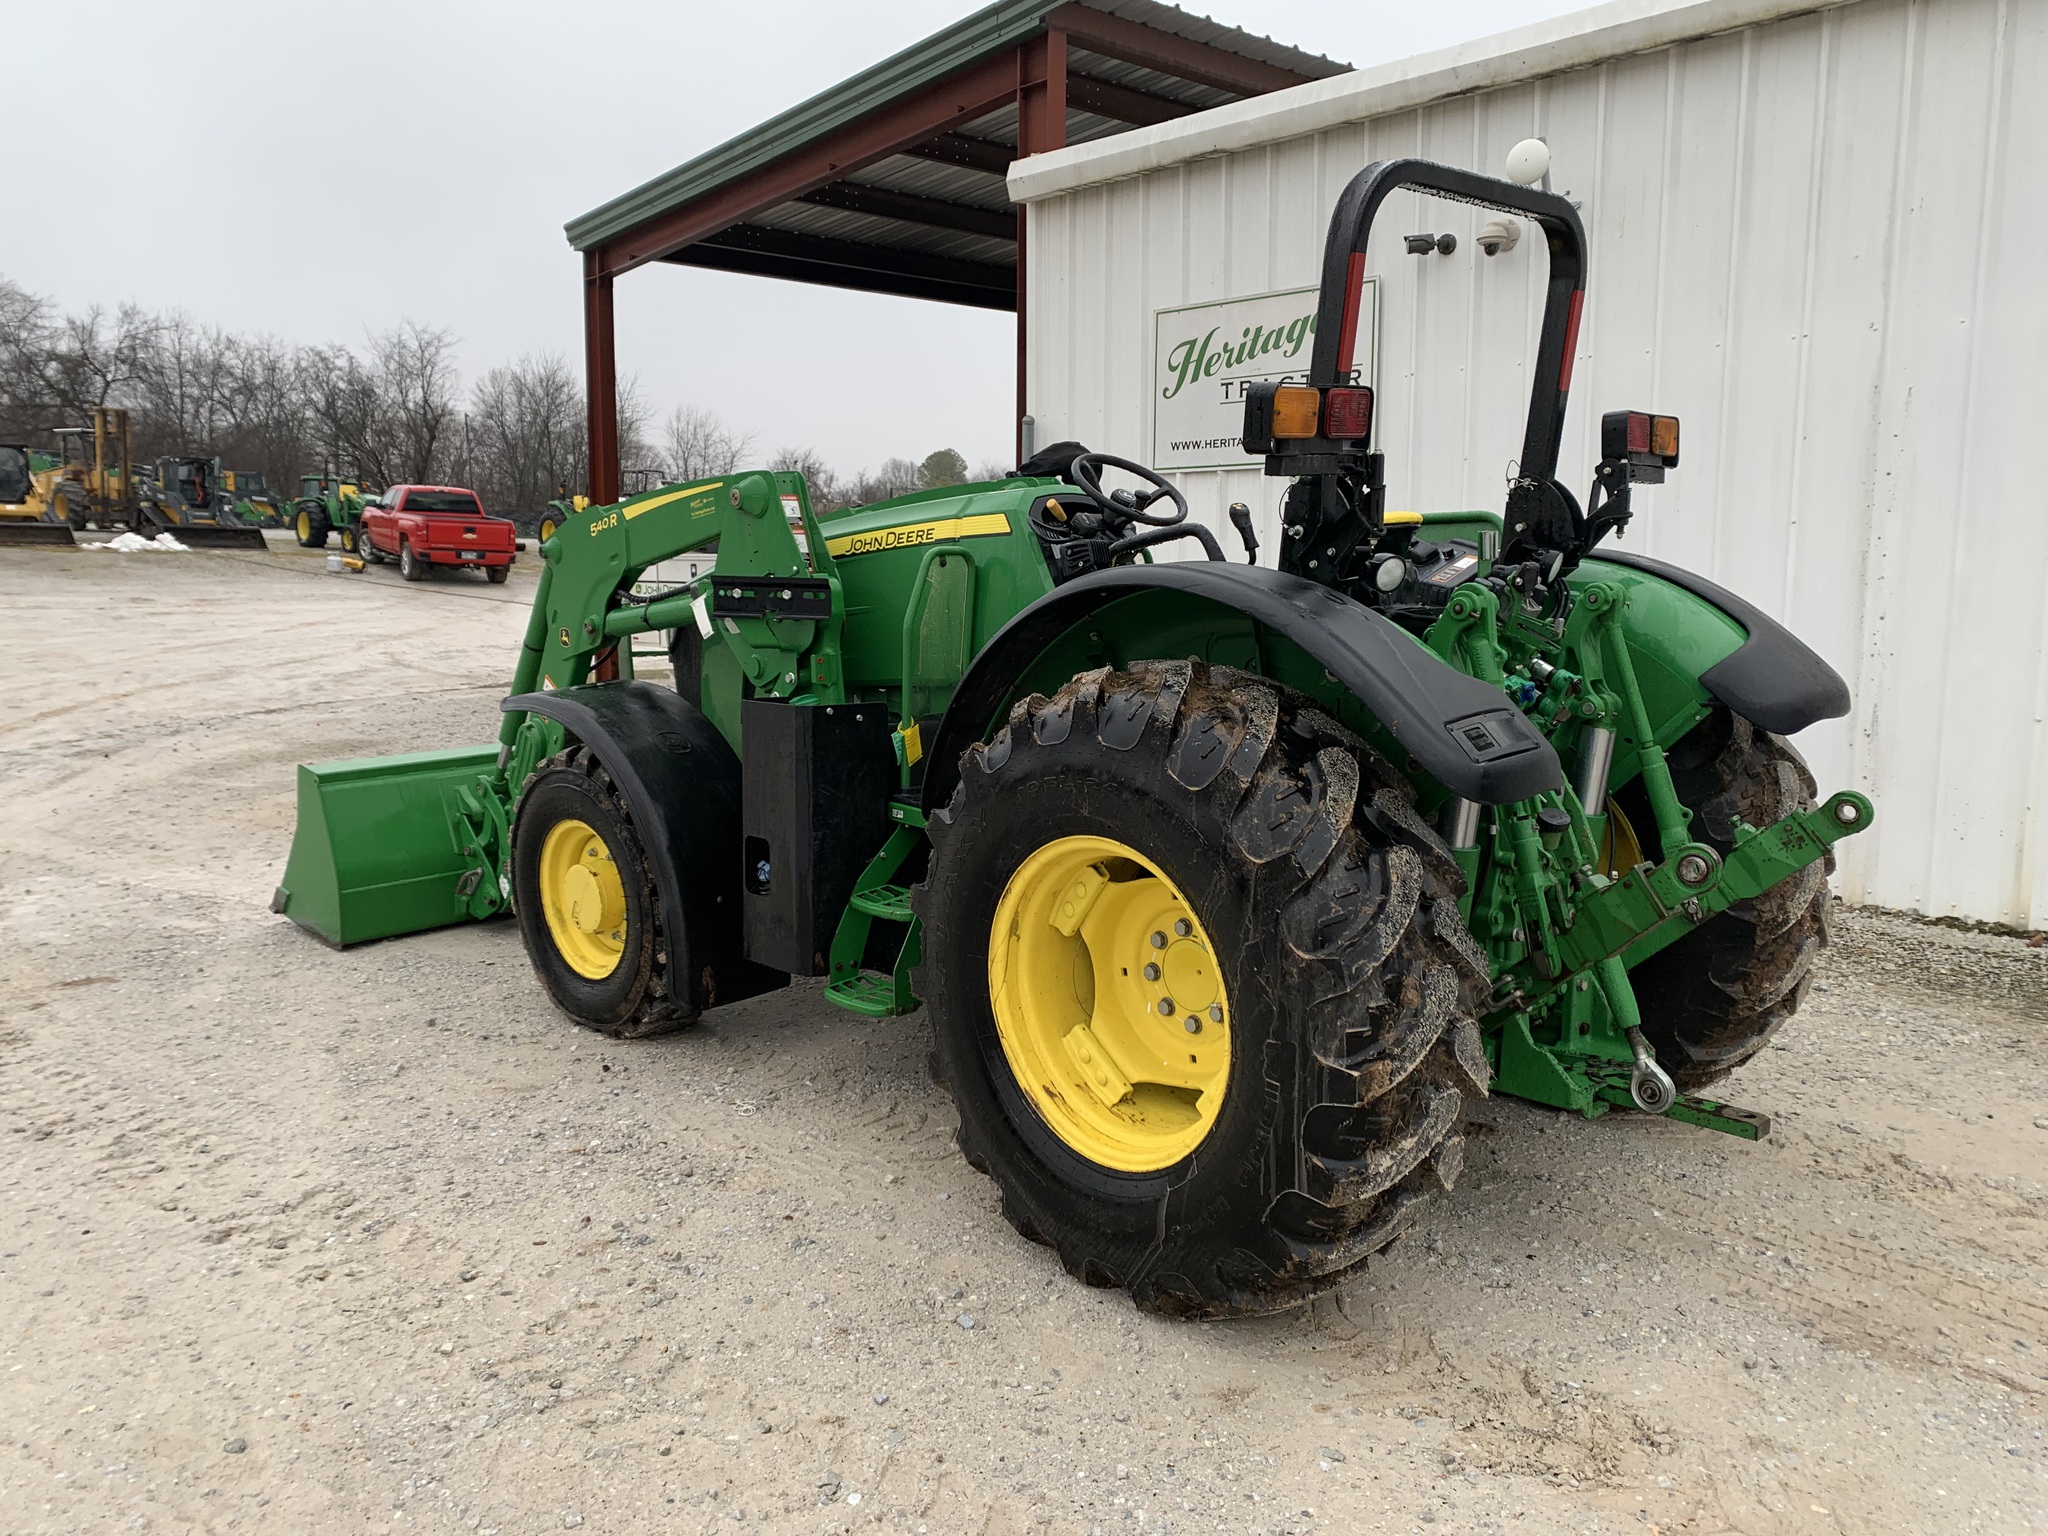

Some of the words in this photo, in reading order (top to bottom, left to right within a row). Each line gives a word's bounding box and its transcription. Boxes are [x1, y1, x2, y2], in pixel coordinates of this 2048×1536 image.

[1170, 436, 1244, 451] WWW.HERITA
[845, 535, 884, 553] JOHN
[885, 528, 936, 547] DEERE
